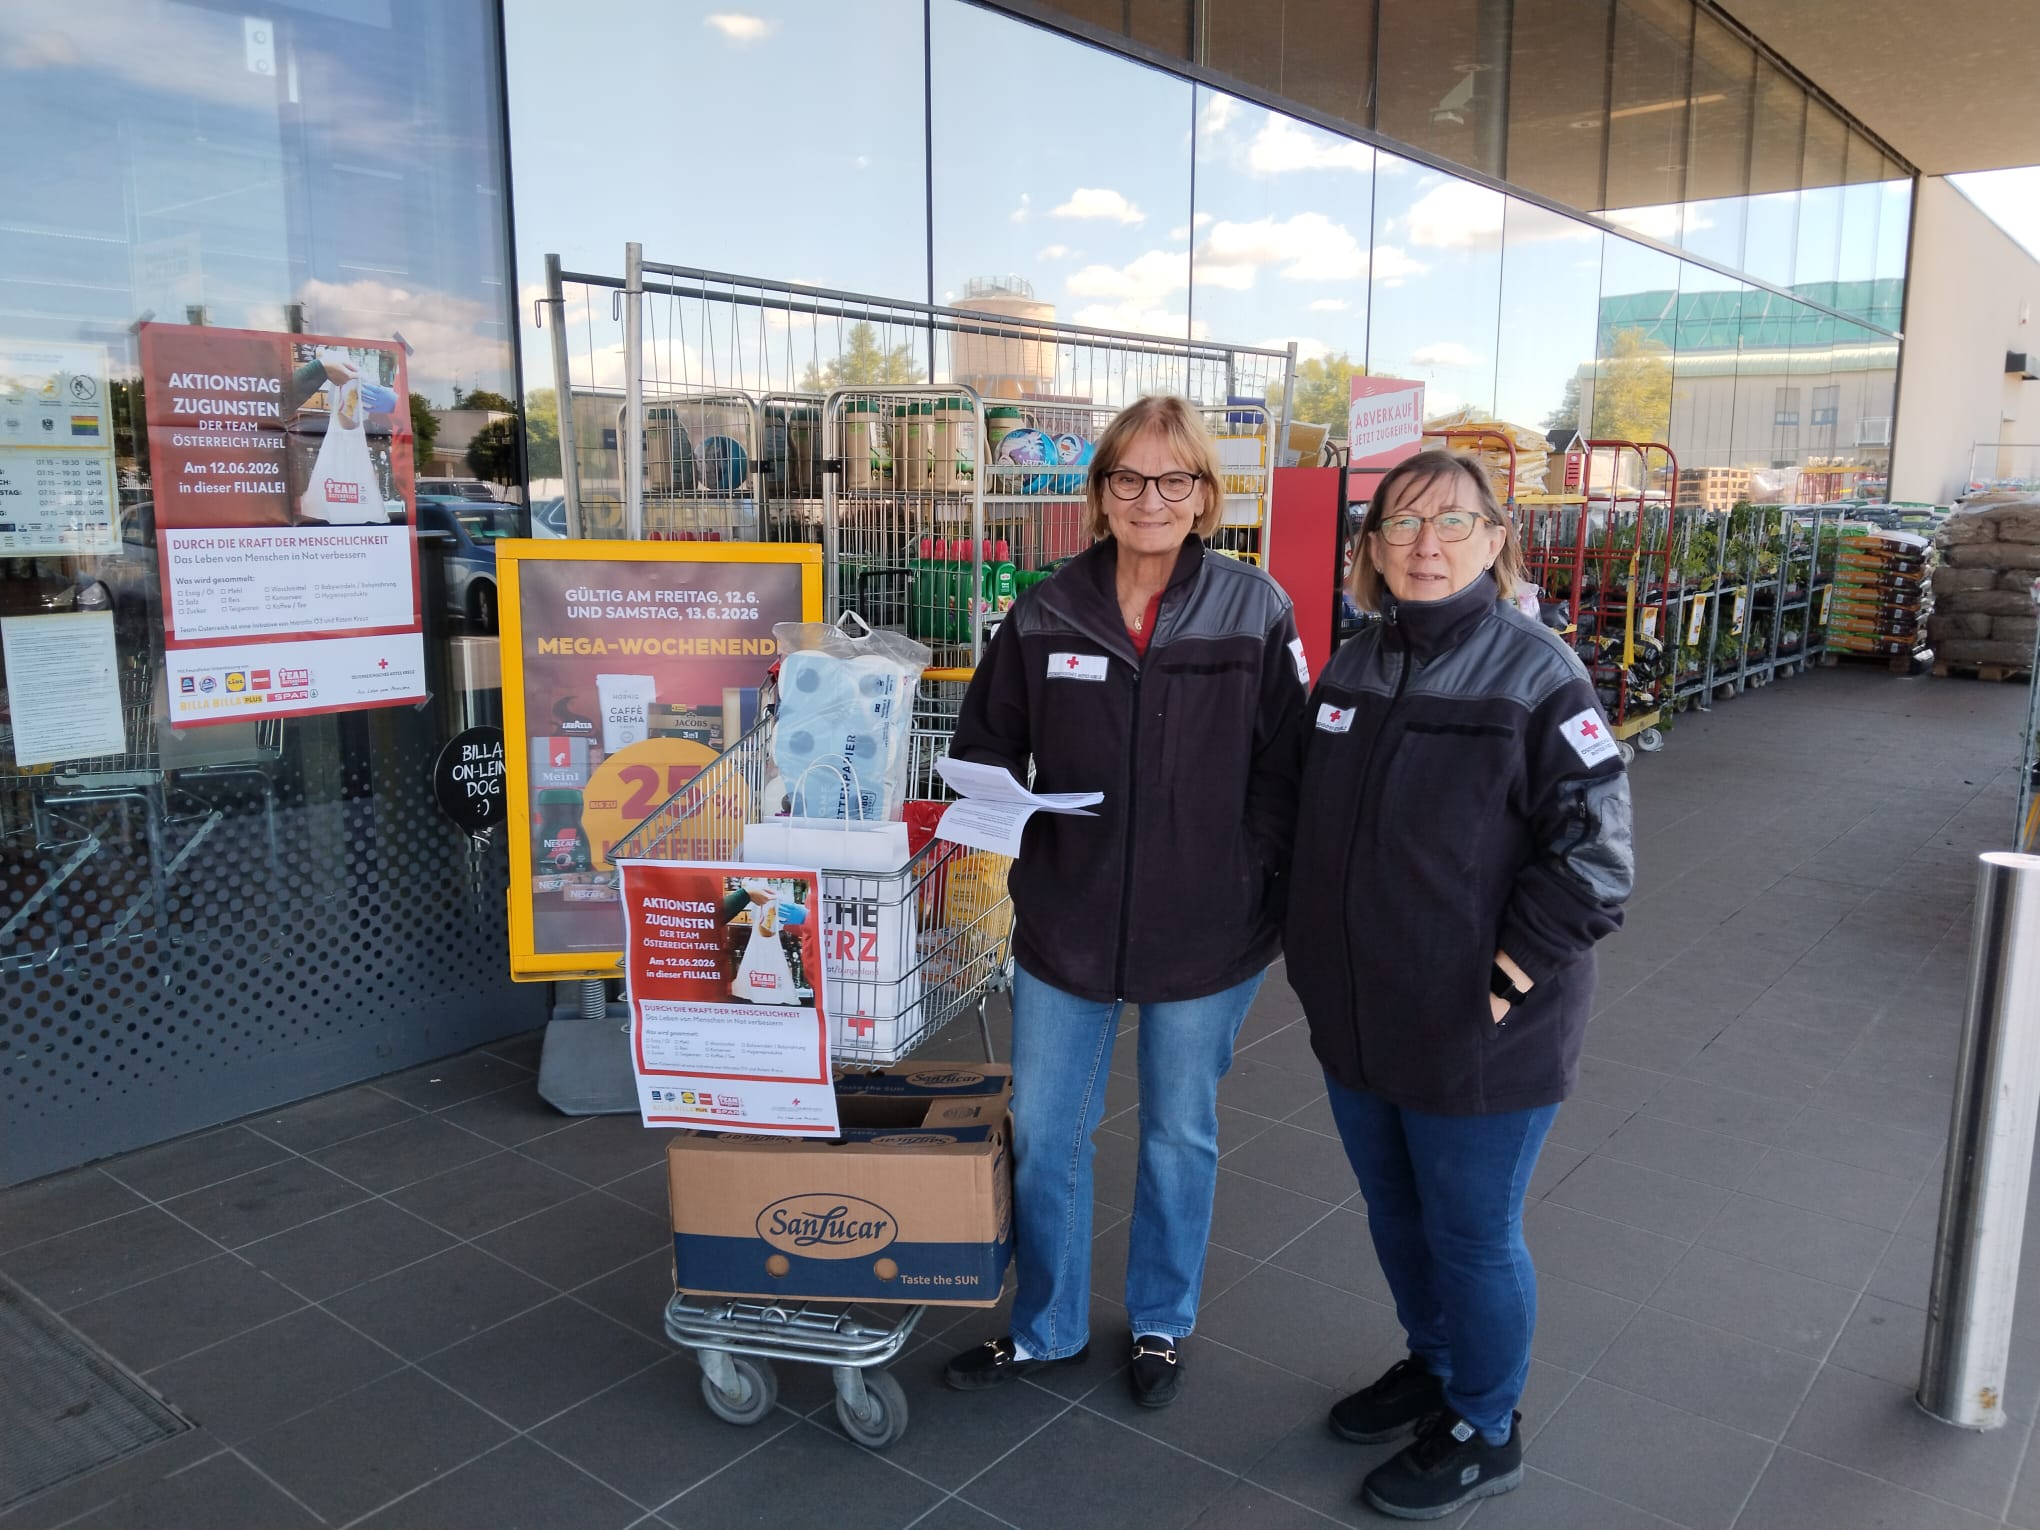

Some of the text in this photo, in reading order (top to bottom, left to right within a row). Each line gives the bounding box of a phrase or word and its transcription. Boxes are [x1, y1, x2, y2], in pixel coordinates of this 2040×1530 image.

[169, 373, 280, 393] AKTIONSTAG
[173, 398, 280, 417] ZUGUNSTEN
[200, 420, 258, 432] DER TEAM
[173, 434, 286, 449] ÖSTERREICH TAFEL
[184, 462, 279, 474] Am 12.06.2026
[179, 481, 285, 494] in dieser FILIALE!
[173, 535, 388, 550] DURCH DIE KRAFT DER MENSCHLICHKEIT
[174, 555, 192, 564] Das
[195, 554, 223, 564] Leben
[245, 552, 289, 562] Menschen
[292, 551, 300, 561] in
[321, 550, 366, 560] verbessern
[176, 575, 255, 585] Was wird gesammelt:
[565, 586, 759, 605] GÜLTIG AM FREITAG, 12.6.
[567, 607, 759, 621] UND SAMSTAG, 13.6.2026
[462, 742, 503, 761] BILLA
[543, 772, 579, 781] Meinl
[467, 779, 500, 797] DOG
[643, 897, 715, 913] AKTIONSTAG
[645, 914, 714, 929] ZUGUNSTEN
[660, 929, 699, 939] DER TEAM
[644, 938, 719, 950] ÖSTERREICH TAFEL
[649, 957, 715, 967] Am 12.06.2026
[656, 970, 682, 979] dieser
[683, 970, 720, 980] FILIALE!
[731, 1009, 800, 1018] MENSCHLICHKEIT
[769, 1206, 887, 1247] SanLucar
[901, 1275, 979, 1285] Taste the SUN
